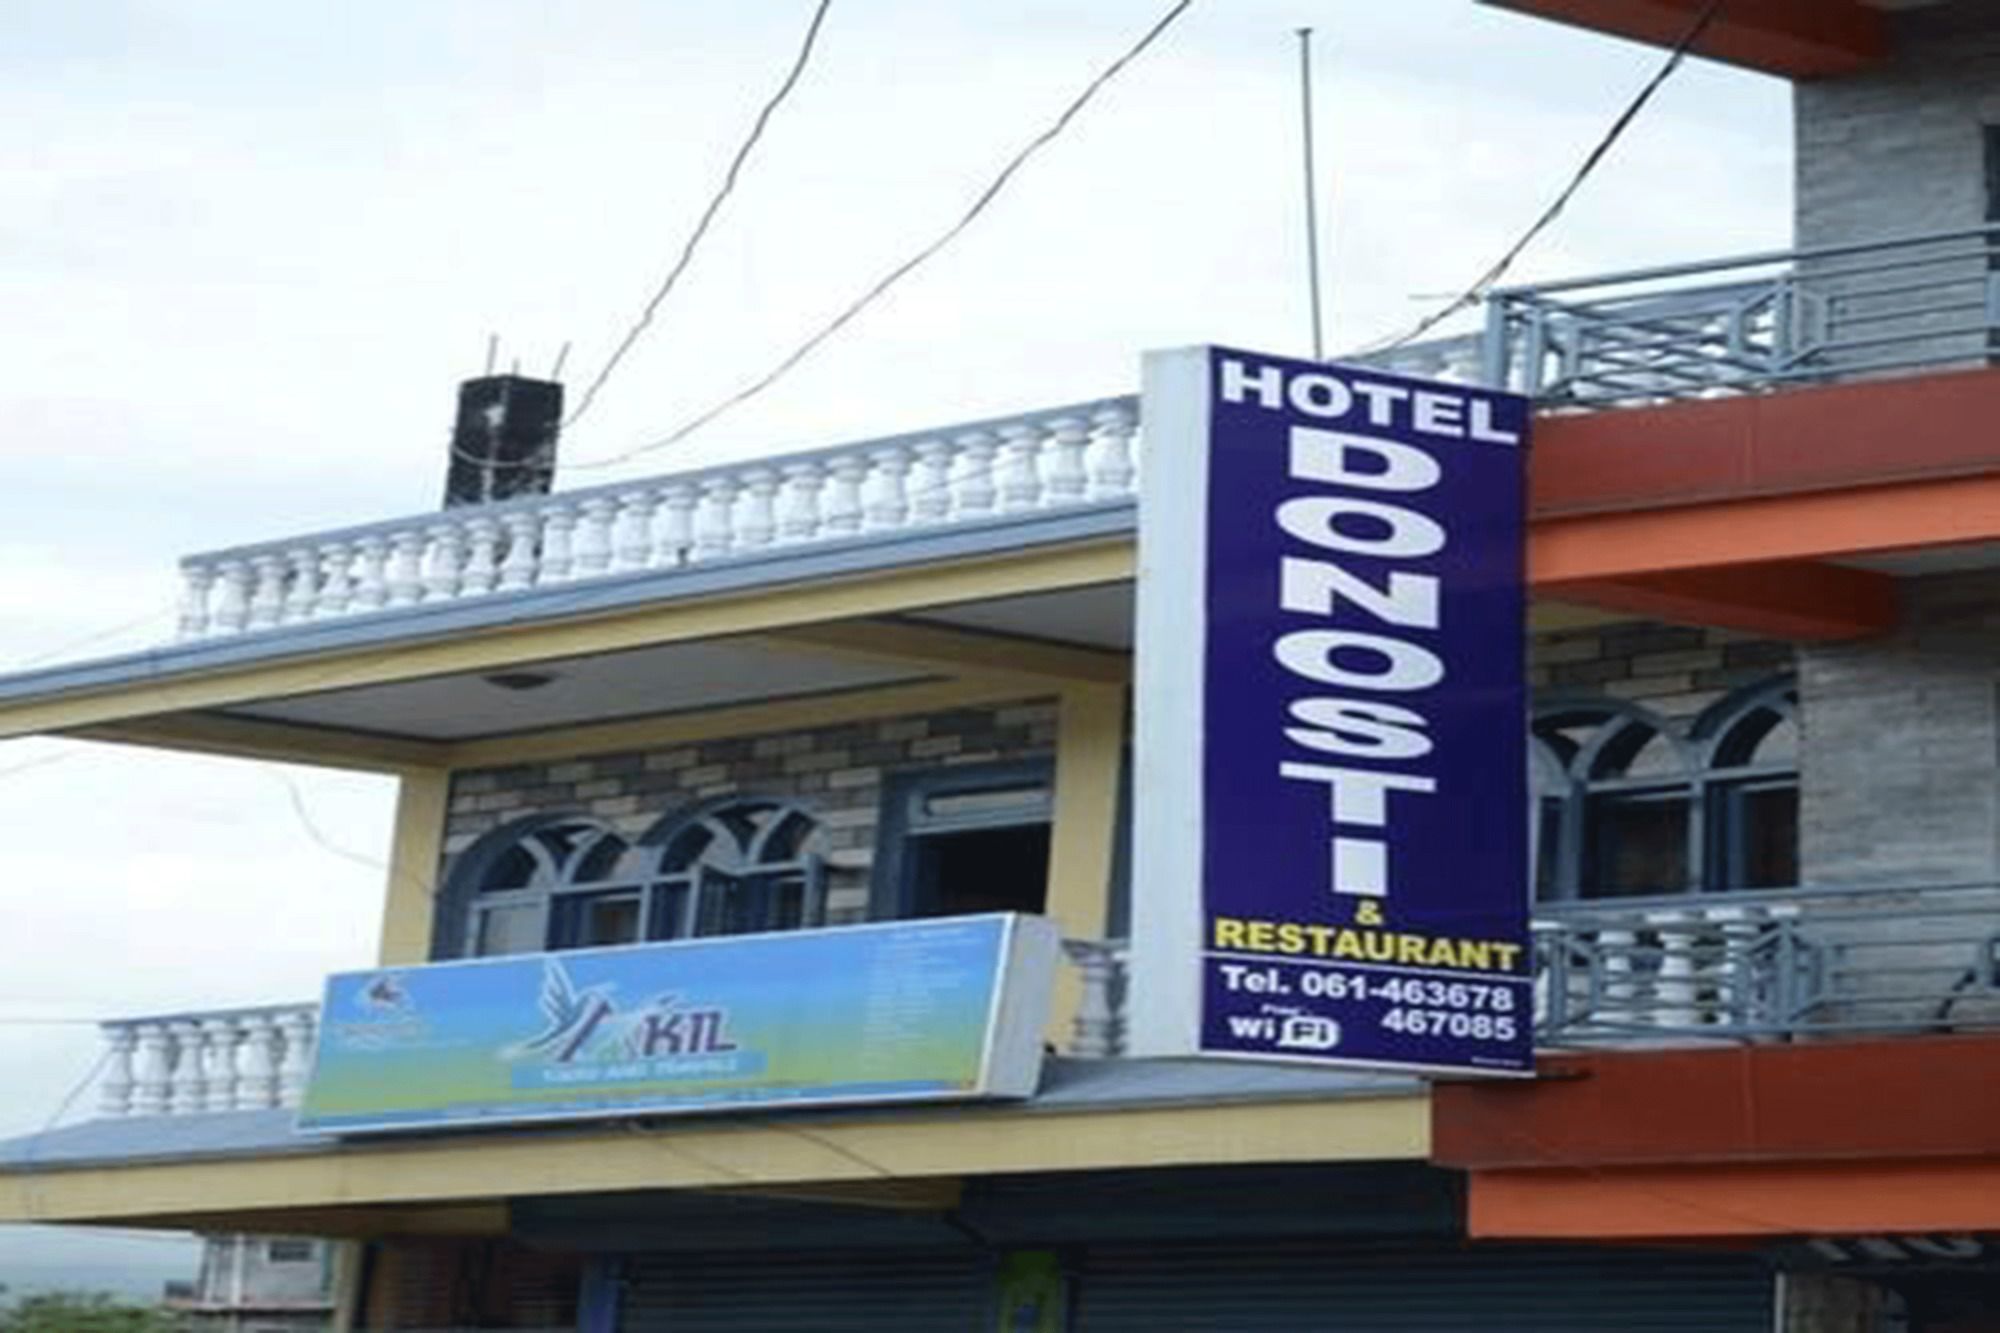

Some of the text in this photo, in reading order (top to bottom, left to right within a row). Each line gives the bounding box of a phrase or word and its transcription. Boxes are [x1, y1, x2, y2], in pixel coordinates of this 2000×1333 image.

[1220, 360, 1519, 446] HOTEL
[1274, 426, 1446, 897] DONOSTI
[1354, 900, 1385, 925] &
[1214, 917, 1521, 970] RESTAURANT
[1221, 965, 1514, 1012] Tel. 061-463678
[1382, 1008, 1517, 1041] 467085
